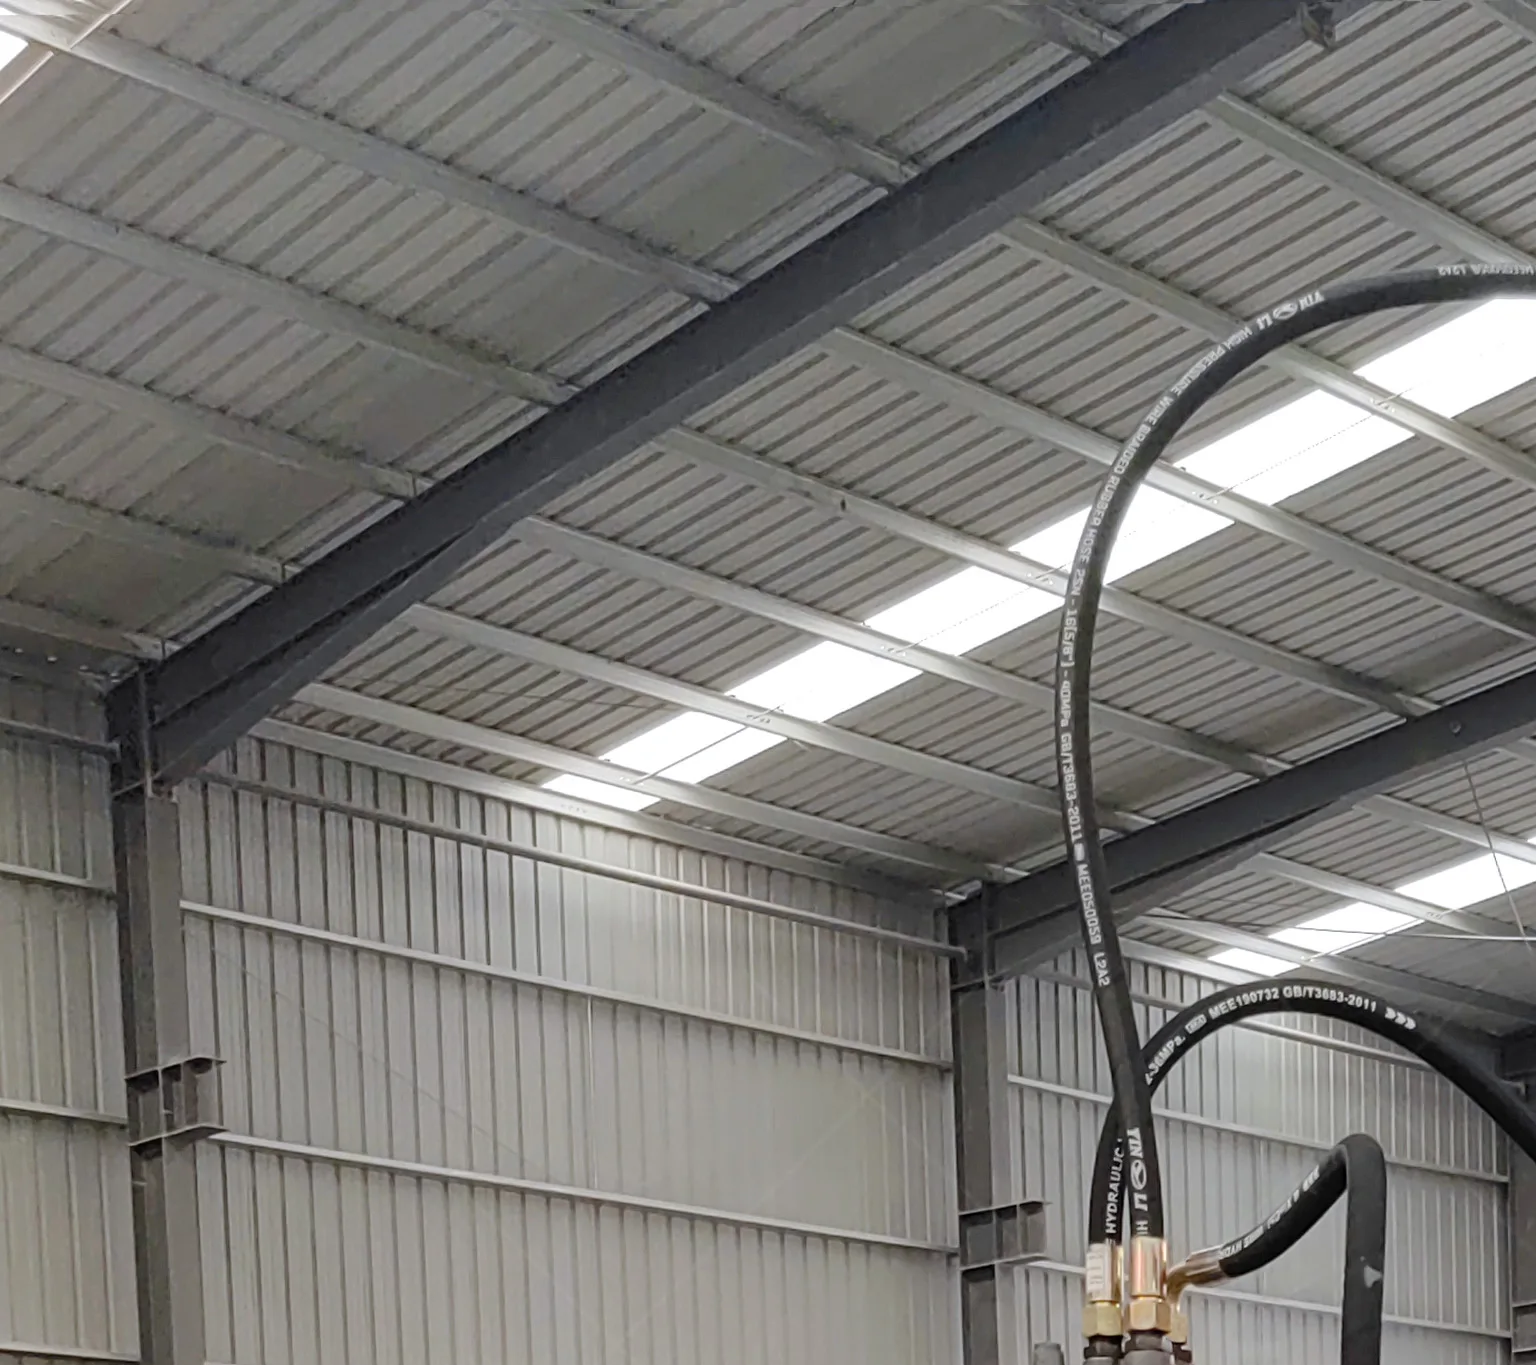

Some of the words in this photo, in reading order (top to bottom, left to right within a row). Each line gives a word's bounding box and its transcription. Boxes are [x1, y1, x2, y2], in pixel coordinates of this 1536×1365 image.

[1144, 395, 1175, 426] WIRE
[1113, 423, 1152, 475] BRAIDED
[1090, 475, 1121, 527] RUBBER
[1079, 528, 1098, 564] HOSE
[1126, 1126, 1144, 1158] YIN
[1105, 1146, 1125, 1234] HYDRAULIC
